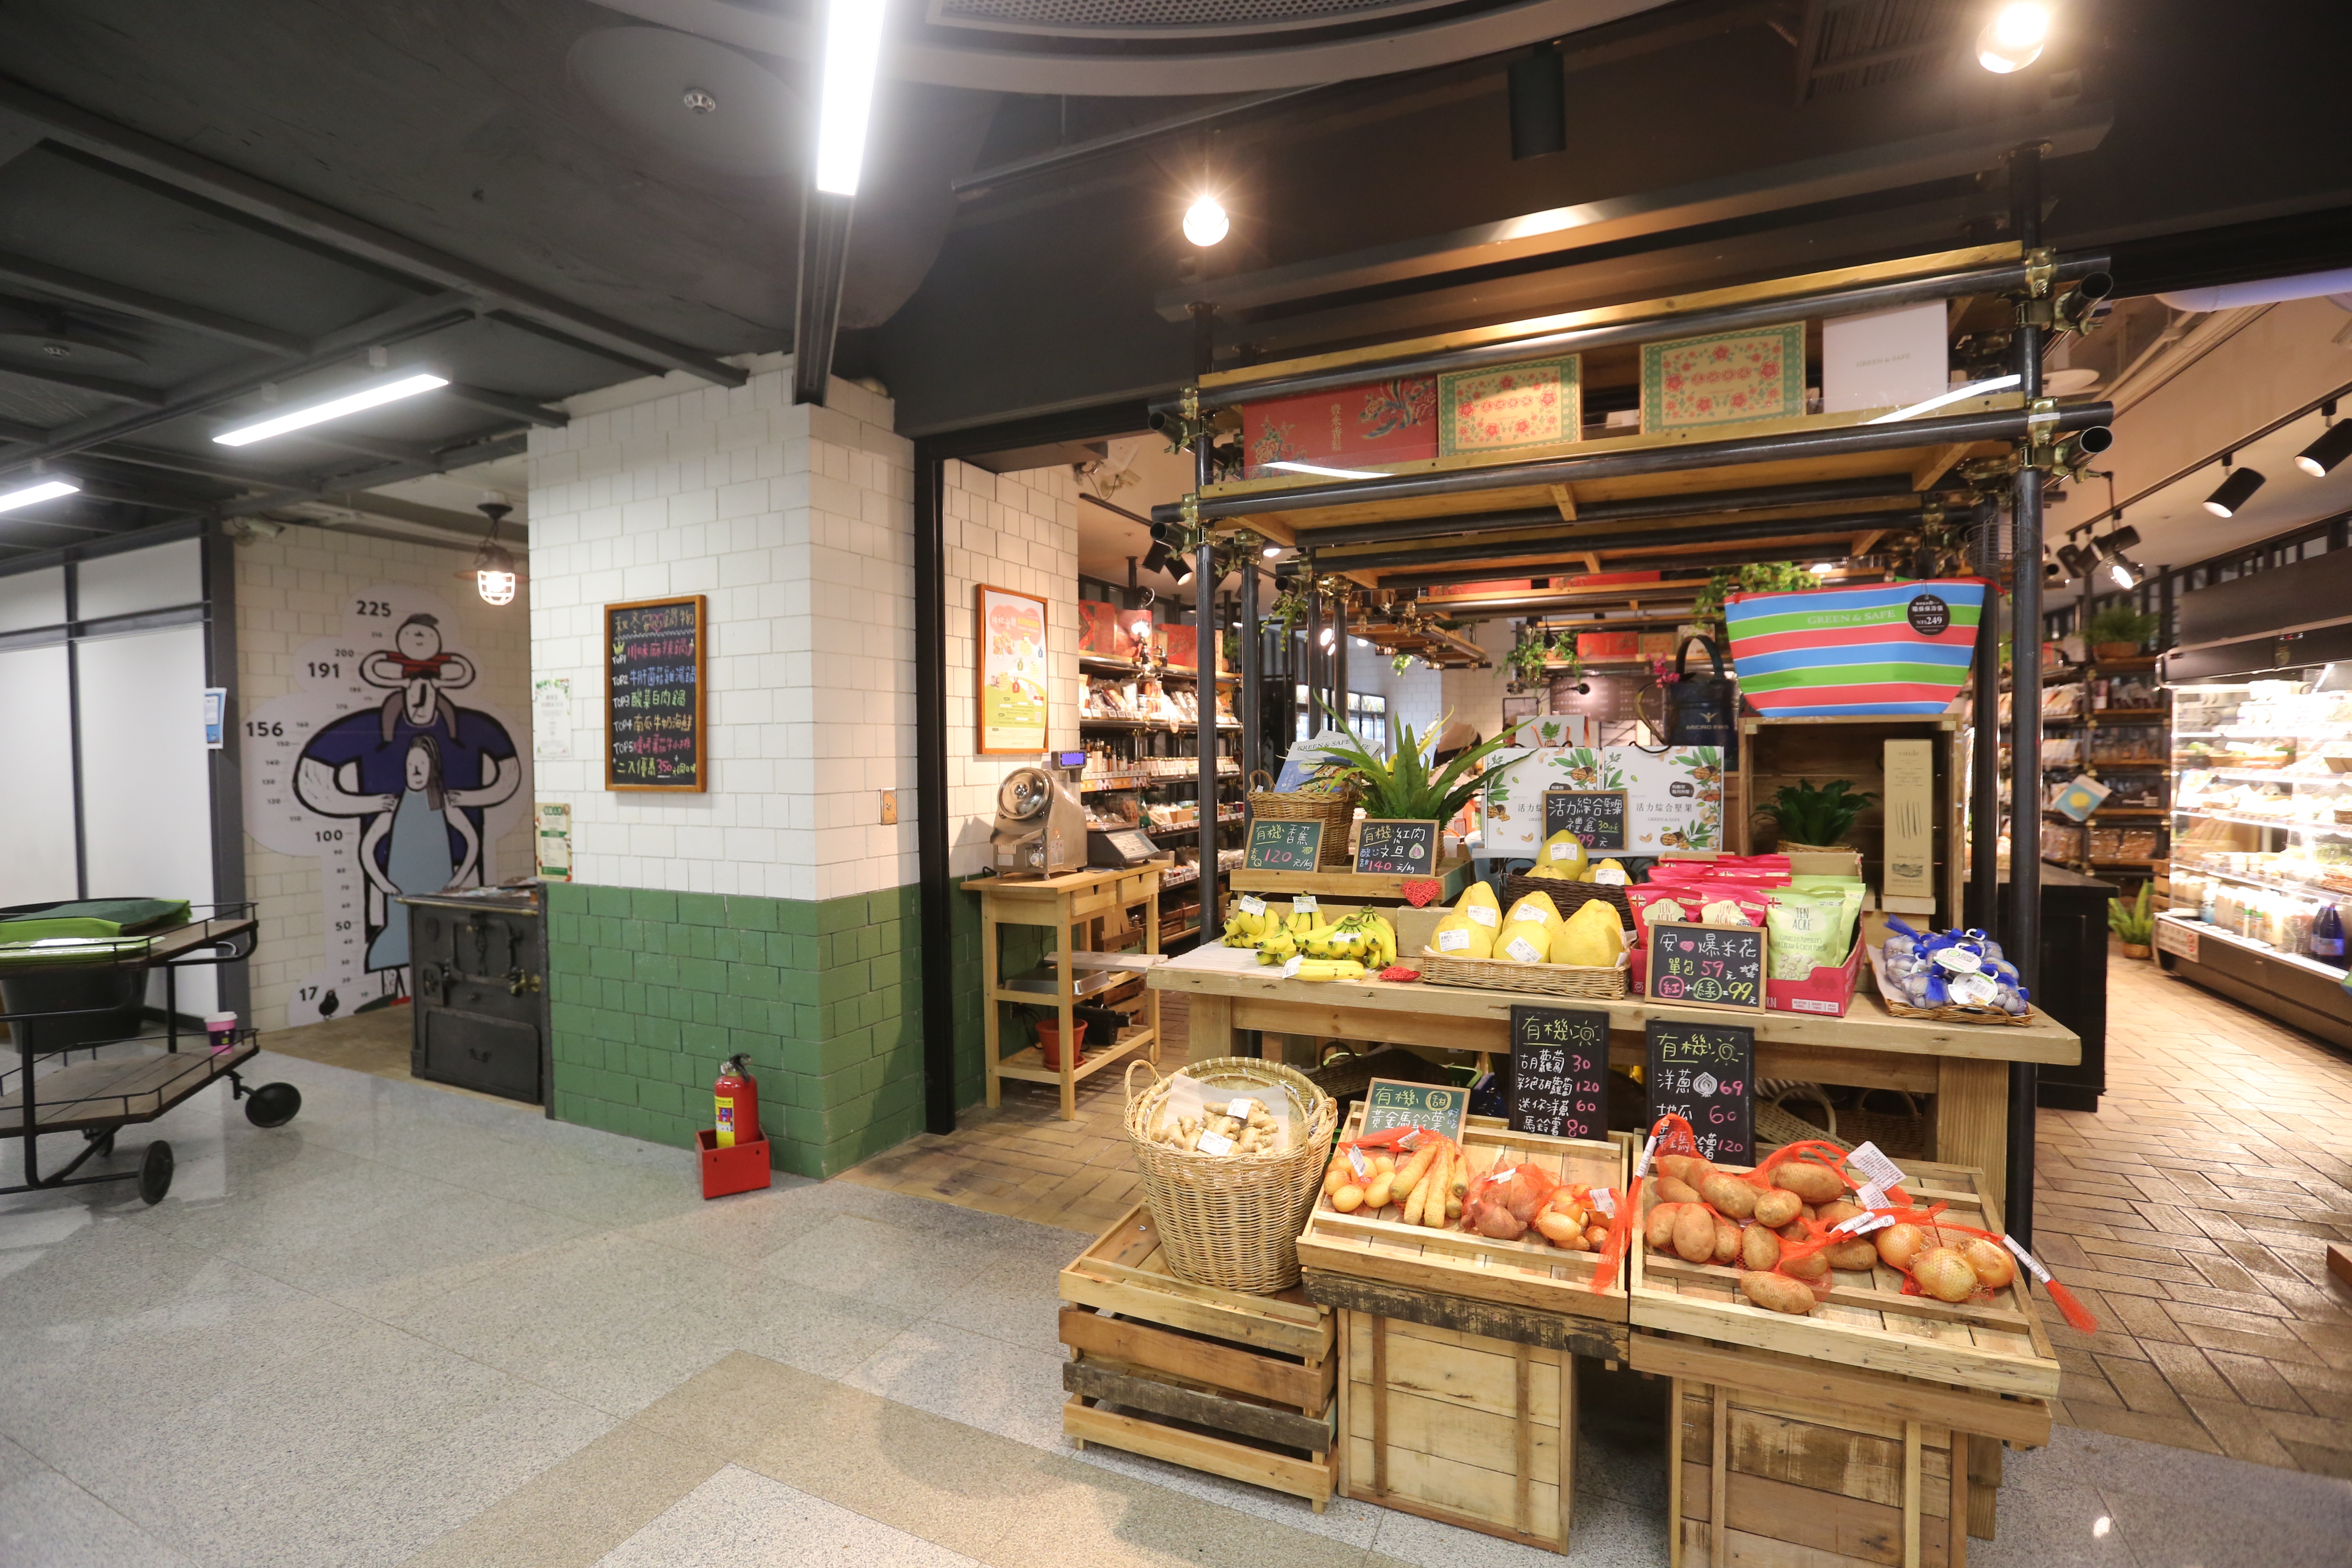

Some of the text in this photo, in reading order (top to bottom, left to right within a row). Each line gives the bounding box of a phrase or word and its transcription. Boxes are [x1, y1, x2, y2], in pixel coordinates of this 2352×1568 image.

[1857, 358, 1883, 367] GREEN
[1892, 353, 1911, 361] SAFE
[356, 600, 391, 617] 225
[1808, 615, 1850, 624] GREEN
[1864, 610, 1896, 620] SAFE
[309, 662, 339, 678] 191
[612, 695, 630, 708] TOP3
[246, 722, 283, 737] 156
[613, 719, 633, 733] TOP4
[613, 741, 633, 755] TOP5
[656, 758, 673, 774] 350
[1548, 797, 1622, 816] 活力綜合堅果
[1566, 816, 1597, 833] 禮盒
[316, 830, 342, 842] 100
[1256, 824, 1310, 845] 有機 香蕉
[1363, 824, 1425, 844] 有機 紅肉
[1573, 834, 1608, 847] 99 元
[1381, 844, 1404, 858] 文旦
[1264, 849, 1313, 870] 120 元/kg
[1369, 860, 1415, 873] 140 元/kg
[1658, 903, 1671, 913] TEN
[1719, 903, 1733, 914] TEN
[1796, 907, 1810, 919] TEN
[336, 921, 351, 931] 50
[1793, 919, 1812, 931] ACRE
[1660, 931, 1757, 958] 安 爆米花
[1668, 958, 1737, 980] 單包 59 元
[300, 986, 318, 1000] 17
[1663, 981, 1680, 994] 紅
[1728, 982, 1754, 1000] 99
[1748, 996, 1757, 1004] 元
[1522, 1016, 1573, 1041] 有機
[1657, 1033, 1711, 1059] 有機
[1520, 1049, 1591, 1074] 胡蘿蔔 30
[1517, 1073, 1599, 1096] 彩色胡蘿蔔 120
[1657, 1069, 1744, 1096] 洋蔥 69
[1375, 1087, 1419, 1106] 有機
[1518, 1098, 1596, 1116] 迷你洋蔥 60
[1709, 1105, 1736, 1124] 60
[1523, 1115, 1588, 1137] 馬鈴薯 80
[1718, 1140, 1743, 1152] 120
